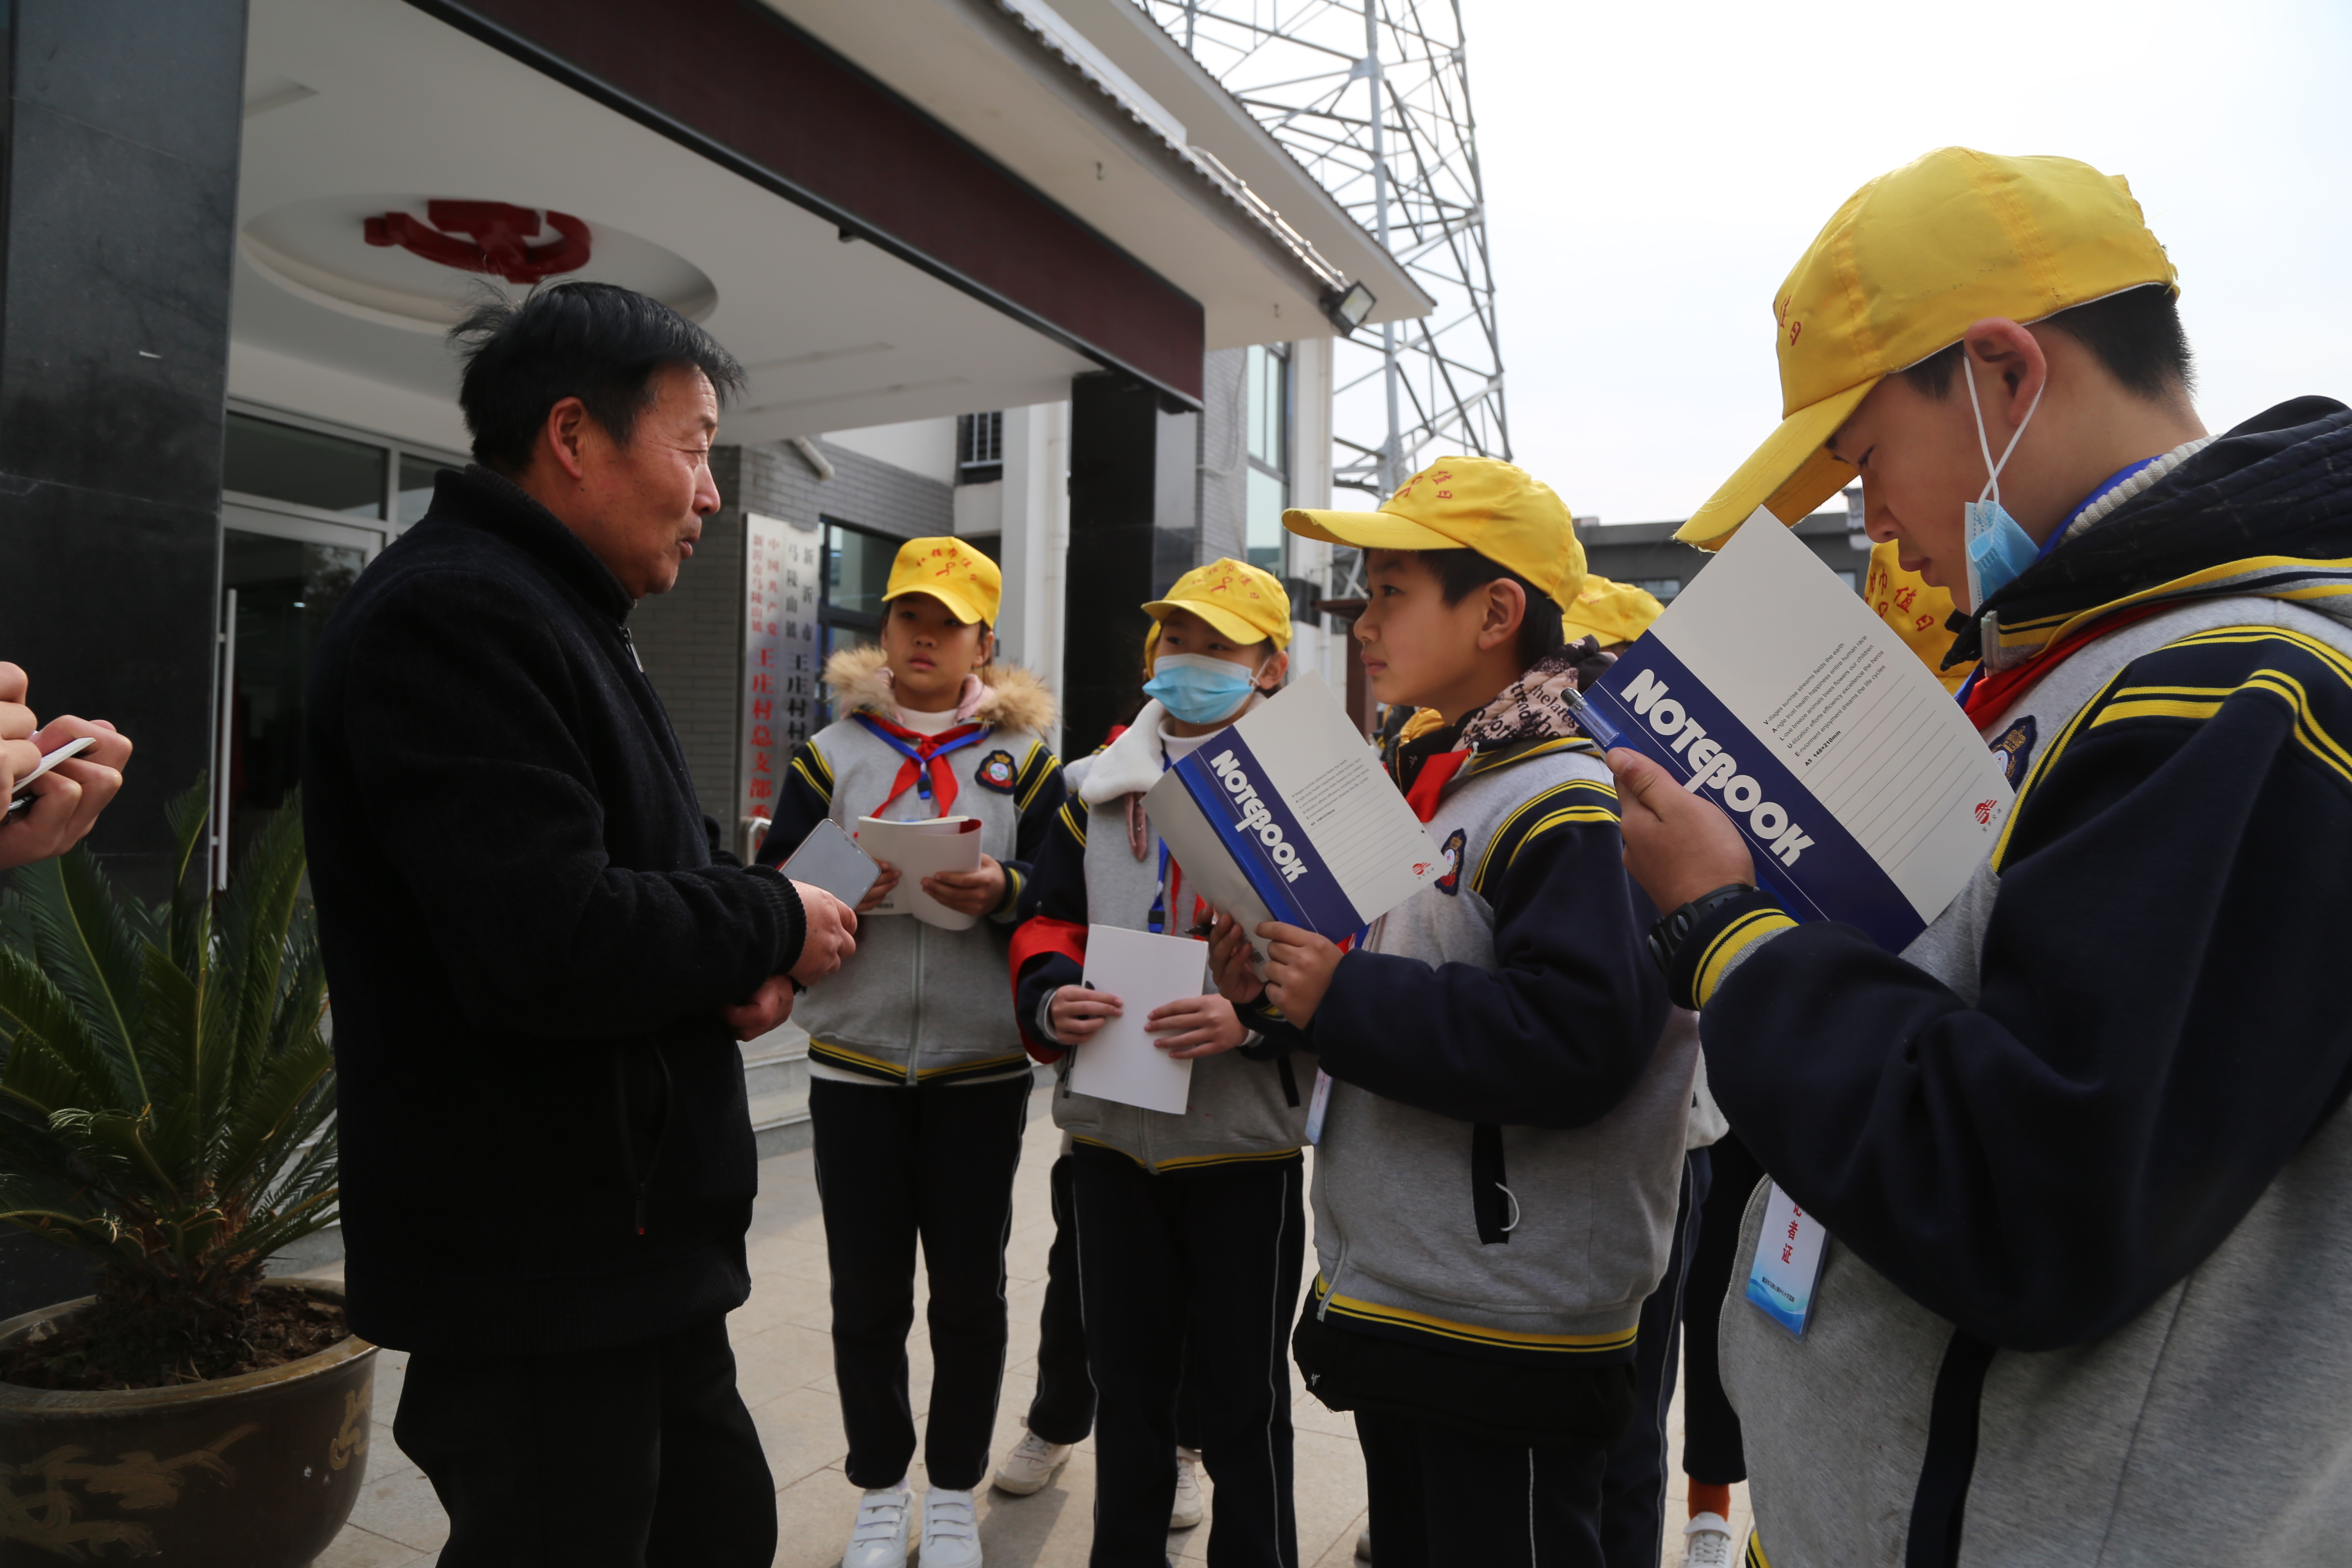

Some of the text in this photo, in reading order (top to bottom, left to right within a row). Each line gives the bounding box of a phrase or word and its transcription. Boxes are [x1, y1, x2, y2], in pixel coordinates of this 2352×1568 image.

[767, 539, 780, 637] 中国共产党
[786, 543, 799, 640] 马陵山镇
[802, 546, 814, 642] 新沂市
[1763, 643, 1844, 724] V-illages sunrise streams fields the earth
[1779, 728, 1793, 741] L-ove
[1791, 713, 1807, 729] breeze
[1807, 697, 1824, 714] animals
[1822, 686, 1834, 697] trees
[1833, 670, 1850, 686] flowers
[1856, 645, 1874, 662] children
[1785, 708, 1797, 719] trust
[1795, 695, 1810, 709] health
[1808, 674, 1831, 696] happiness
[1830, 661, 1843, 674] entire
[1841, 646, 1857, 662] human
[1856, 635, 1867, 646] race
[1786, 726, 1810, 748] U-tilization
[1809, 713, 1823, 727] efforts
[1822, 693, 1843, 714] efficiency
[1842, 671, 1864, 694] excellence
[1870, 650, 1883, 664] heros
[1820, 709, 1843, 732] enjoyment
[1842, 693, 1858, 710] dreams
[1856, 686, 1865, 694] the
[1871, 665, 1885, 679] cycles
[749, 648, 775, 850] 王庄村总支部委
[1620, 669, 1815, 867] NOTEBOOK
[1805, 758, 1812, 766] A5
[1210, 750, 1308, 883] NOTEBOOK
